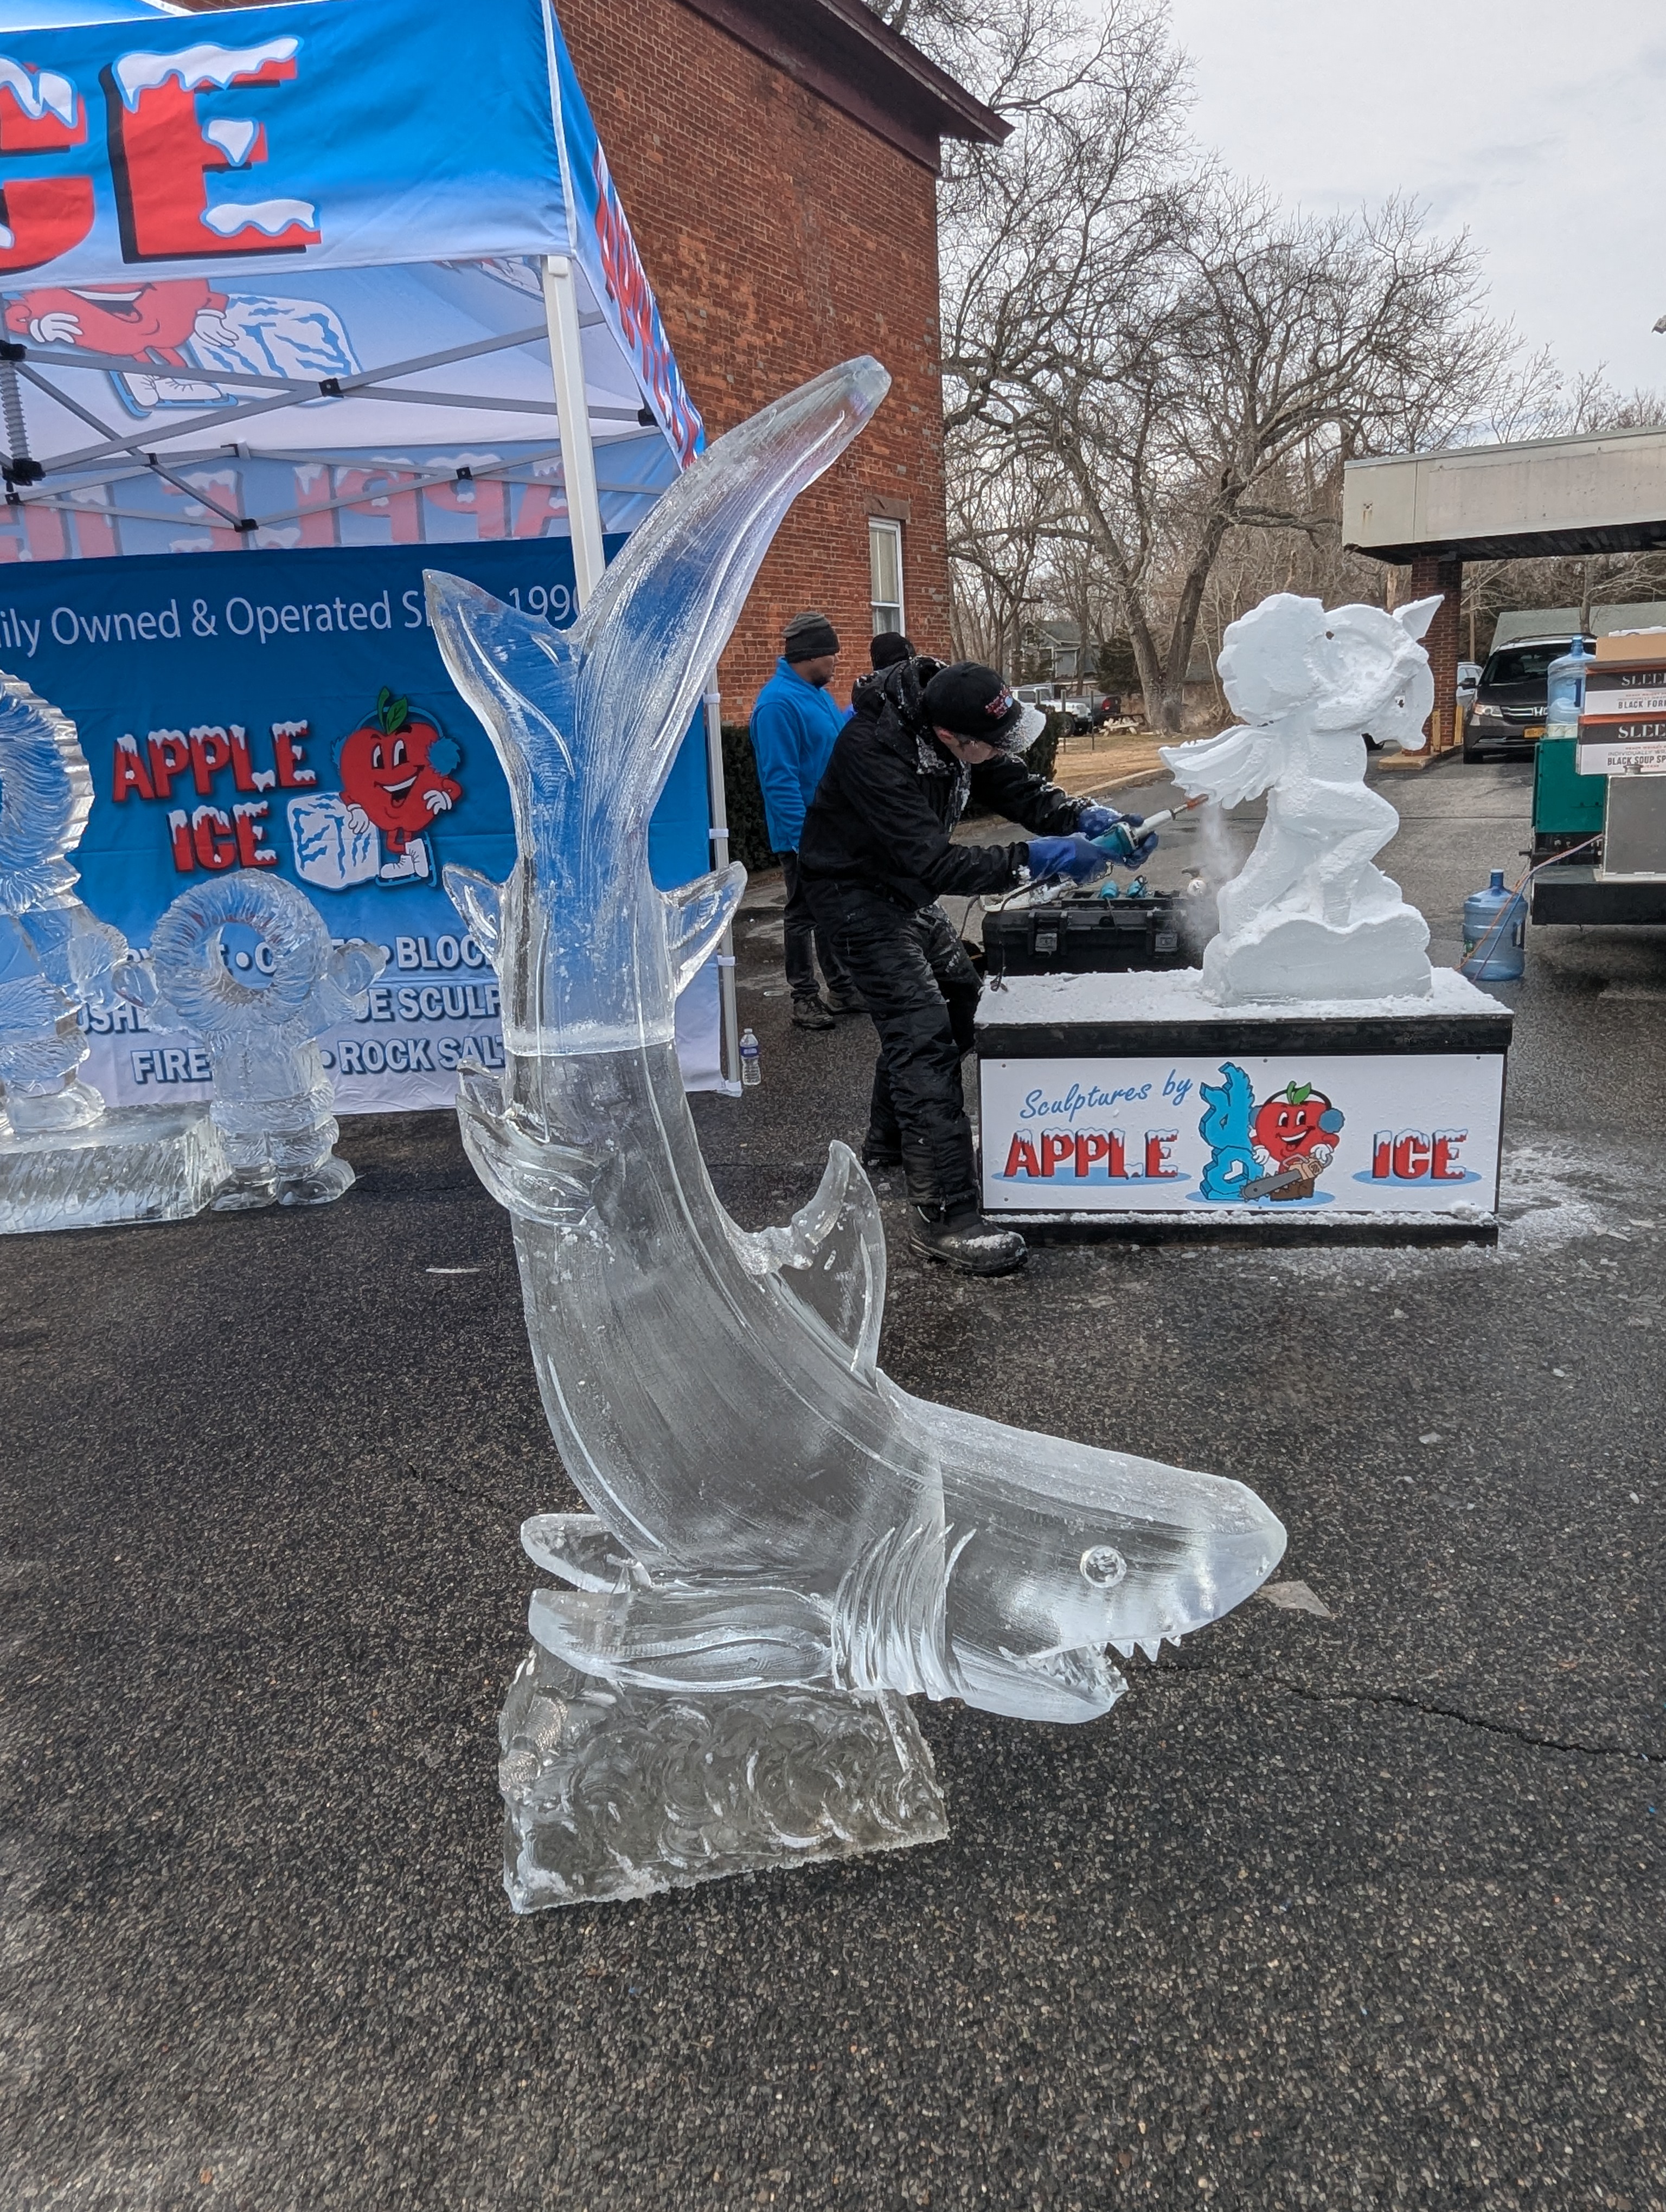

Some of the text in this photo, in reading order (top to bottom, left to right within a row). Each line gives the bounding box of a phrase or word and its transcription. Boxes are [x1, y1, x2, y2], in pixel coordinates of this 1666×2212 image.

[0, 608, 40, 658] ily
[51, 599, 182, 645] Owned
[191, 599, 218, 636] &
[226, 590, 392, 644] Operated
[1618, 700, 1644, 709] BLACK
[112, 719, 318, 803] APPLE
[1607, 756, 1632, 766] BLACK
[1635, 755, 1655, 764] SOUP
[166, 800, 279, 873] ICE
[395, 934, 491, 969] BLOC
[398, 983, 502, 1021] SCULP
[131, 1047, 213, 1083] FIRE
[337, 1038, 434, 1074] ROCK
[1020, 1069, 1193, 1123] Sculptures by
[1003, 1127, 1468, 1179] APPLE ICE
